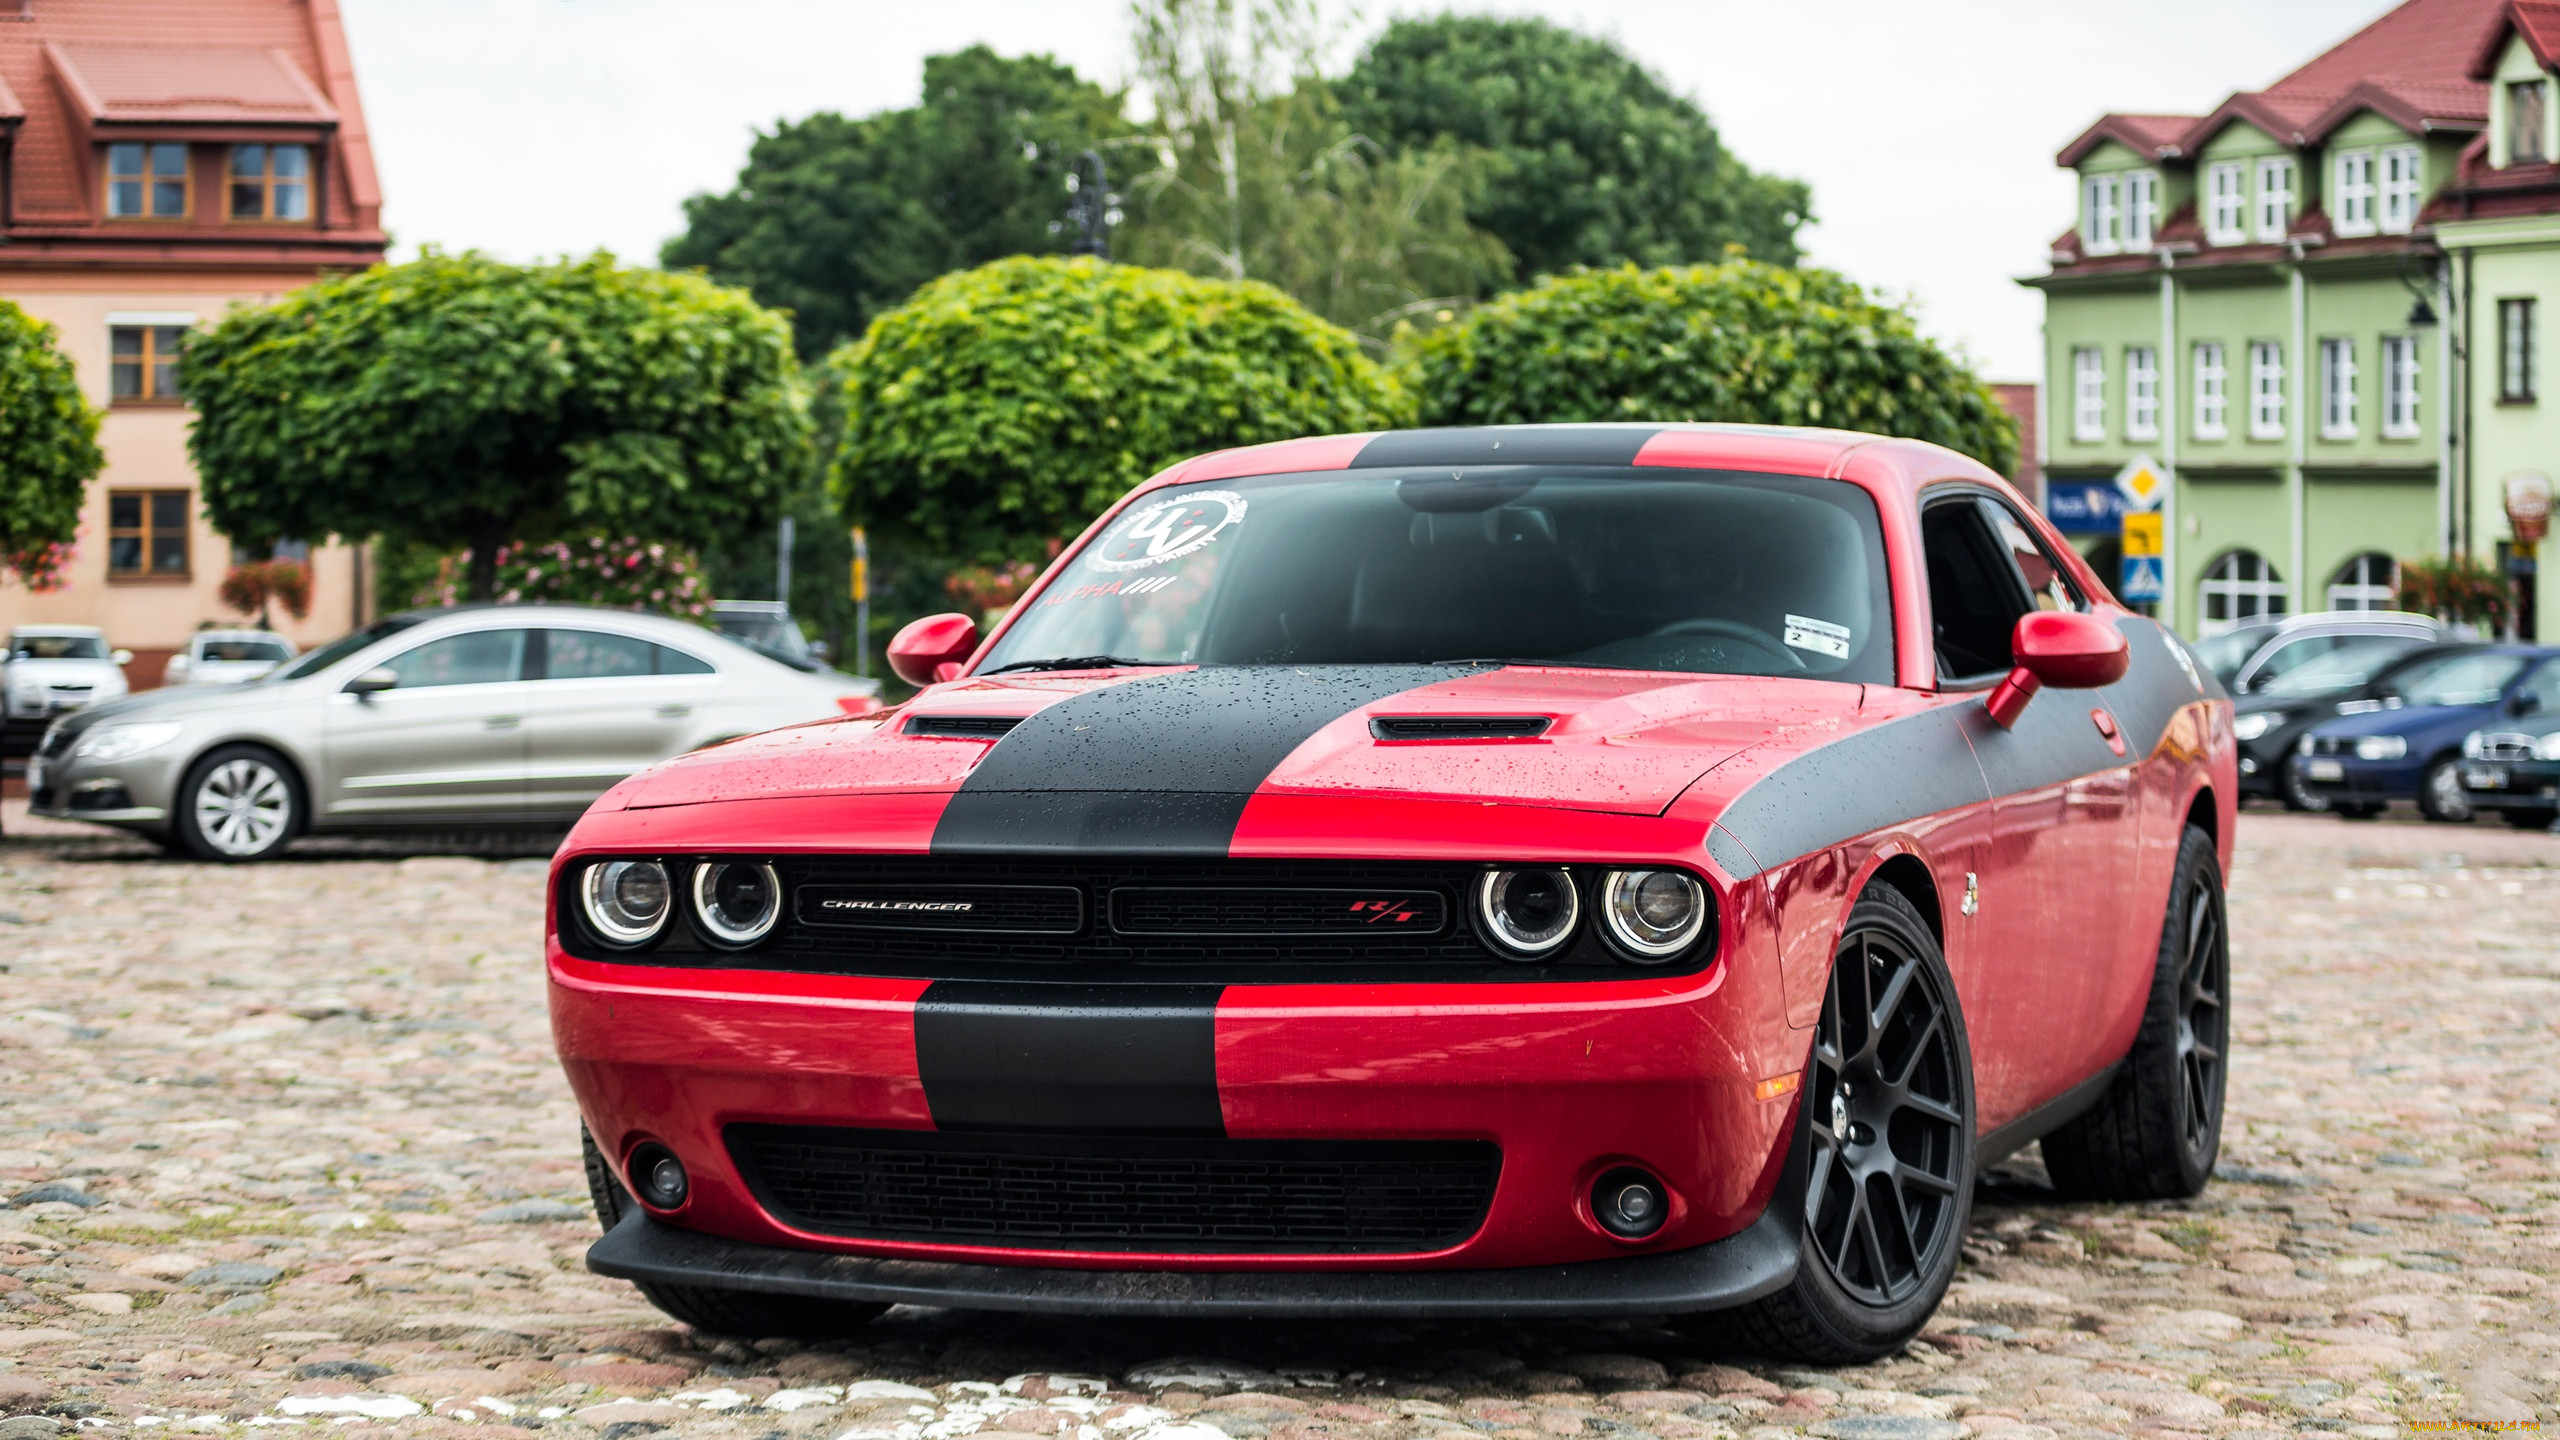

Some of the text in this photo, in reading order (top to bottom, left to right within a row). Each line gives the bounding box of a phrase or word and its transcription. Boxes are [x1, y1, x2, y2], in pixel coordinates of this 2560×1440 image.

[1038, 580, 1123, 610] ALPHA
[1791, 632, 1843, 651] 2 7
[821, 899, 974, 912] CHALLENGER
[1348, 899, 1423, 923] R/T
